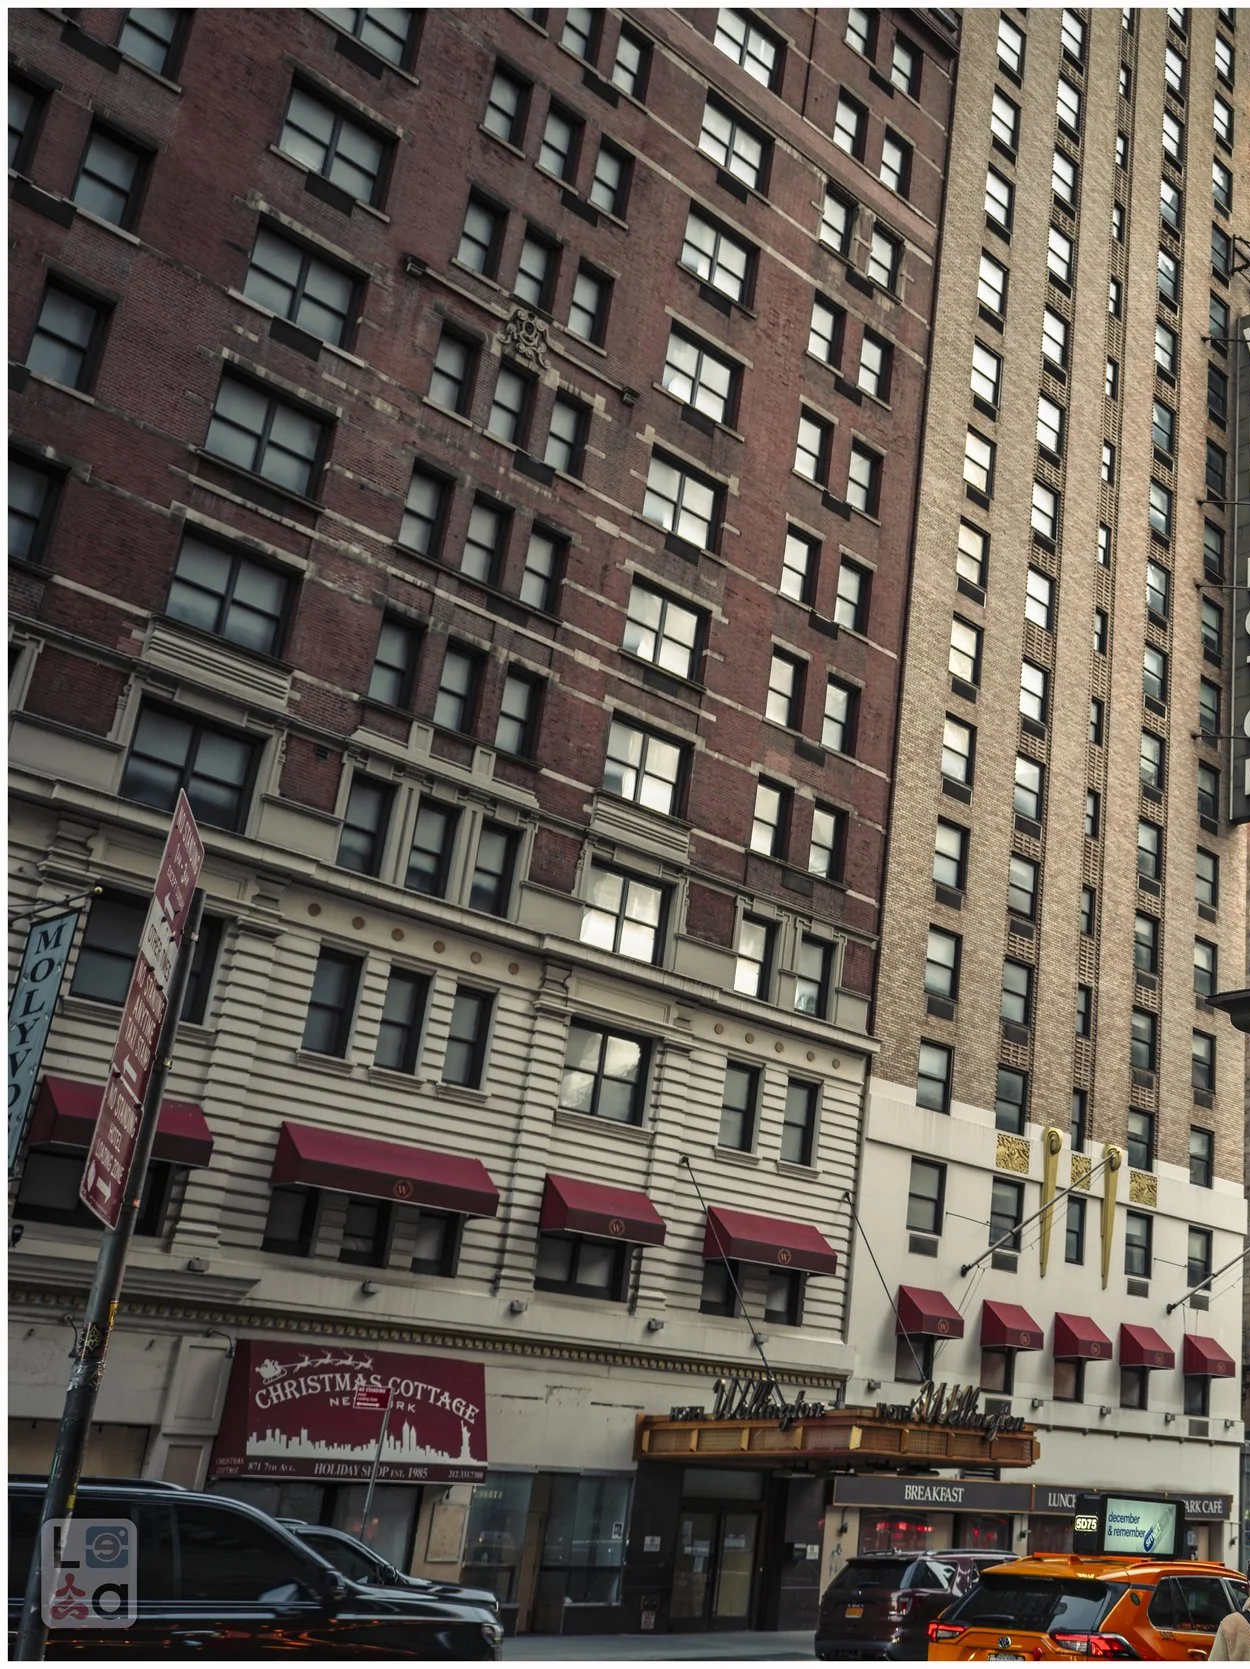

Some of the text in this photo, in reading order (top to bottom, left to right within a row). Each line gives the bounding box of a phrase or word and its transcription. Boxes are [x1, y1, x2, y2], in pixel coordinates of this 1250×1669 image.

[147, 923, 162, 962] OTHER
[135, 958, 165, 1024] NO STANDING
[8, 922, 68, 1135] MOLYVO
[132, 994, 156, 1046] ANYTIME
[124, 1016, 151, 1072] TAXI STAND
[107, 1081, 138, 1139] NO STANDING
[107, 1121, 123, 1153] HOTEL
[94, 1136, 114, 1173] LOADING
[110, 1157, 125, 1185] ZONE
[255, 1373, 480, 1424] CHRISTMAS COTTAGE
[216, 1457, 244, 1466] CHRISTMAS
[248, 1462, 261, 1472] 871
[314, 1463, 360, 1477] HOLIDAY
[408, 1467, 429, 1479] 1985
[904, 1484, 964, 1504] BREAKFAST
[1182, 1498, 1224, 1514] ARK CAFÉ
[1075, 1518, 1097, 1530] 5D75
[1107, 1525, 1146, 1538] & remember
[1108, 1512, 1141, 1524] december
